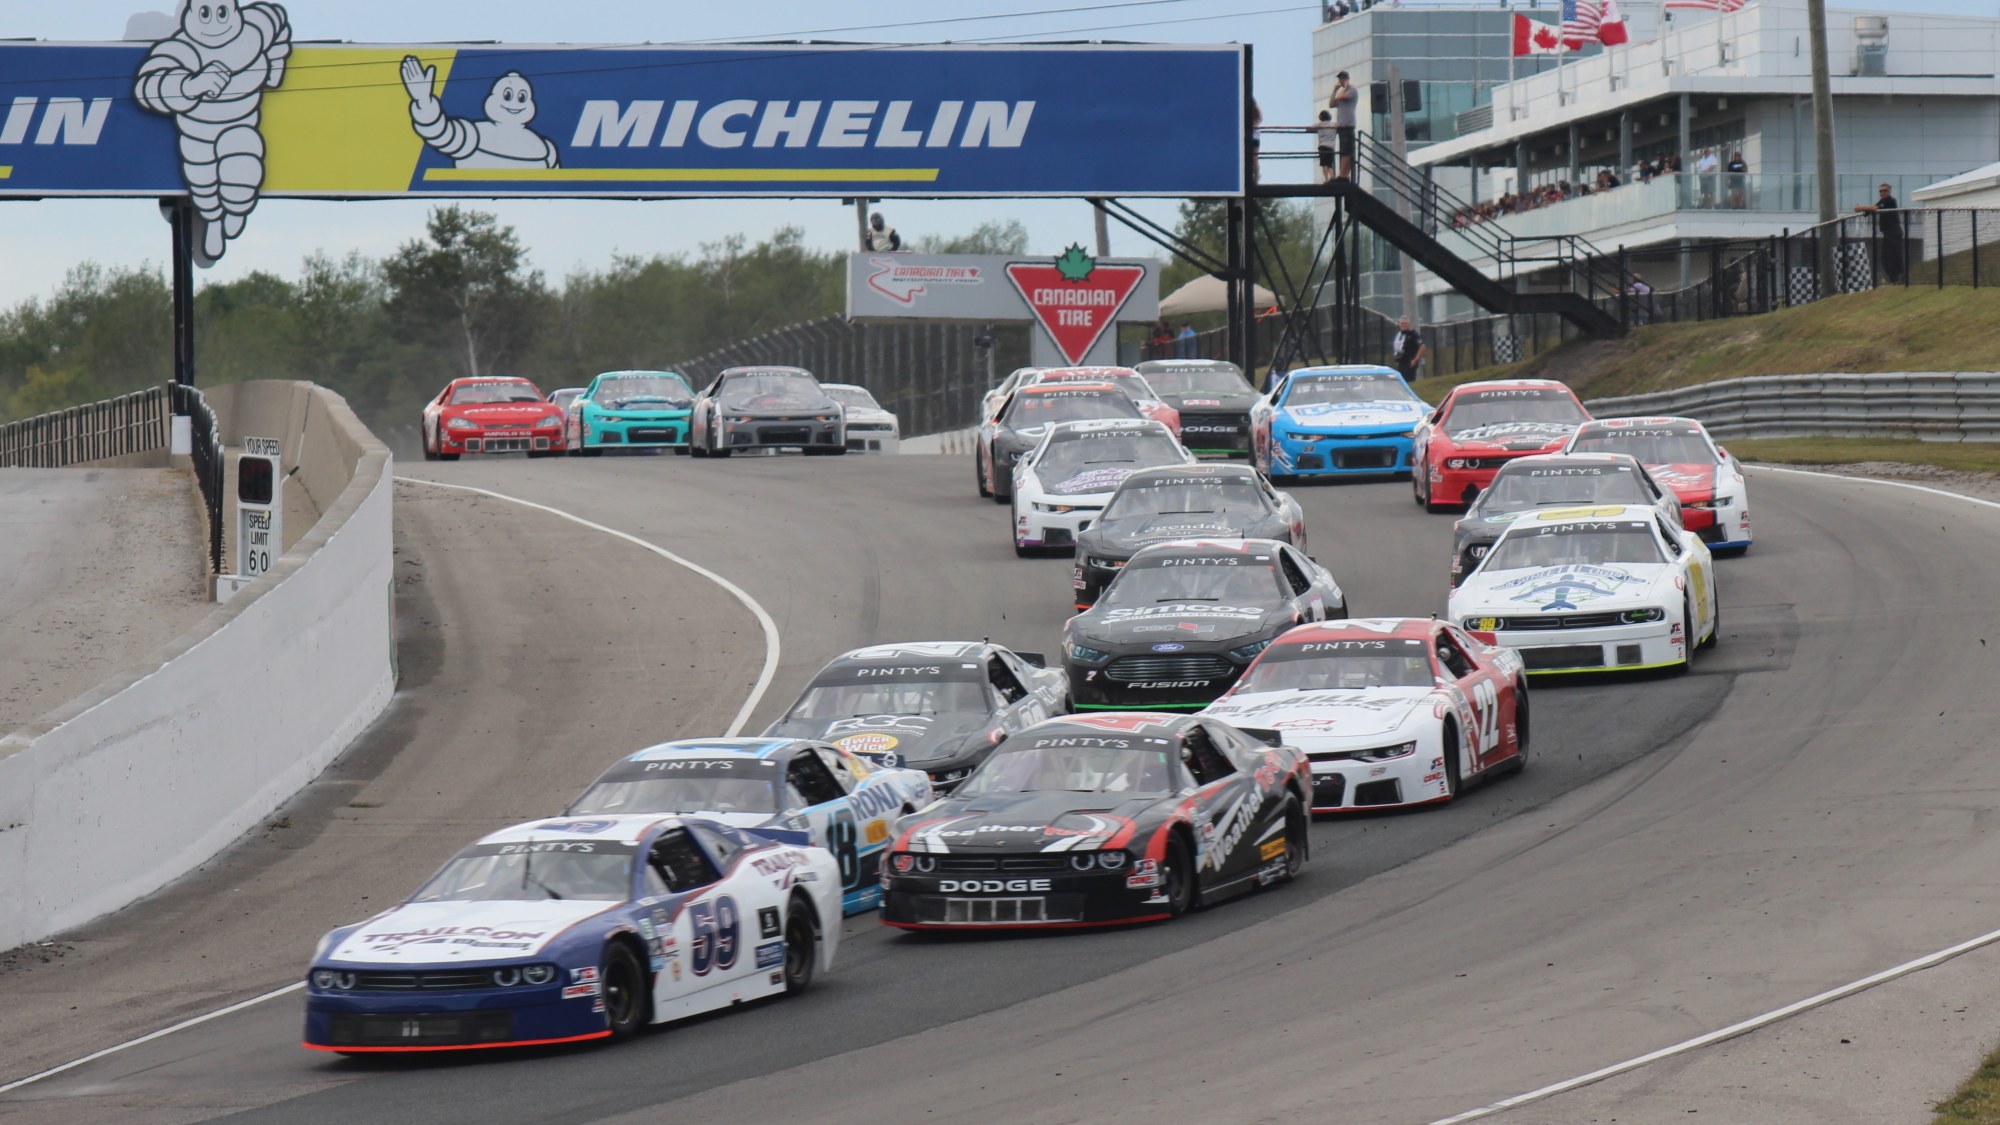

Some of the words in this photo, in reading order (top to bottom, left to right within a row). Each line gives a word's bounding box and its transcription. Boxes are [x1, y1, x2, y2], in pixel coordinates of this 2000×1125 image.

[570, 100, 1036, 148] MICHELIN
[894, 267, 943, 277] CANADIAN
[946, 267, 967, 277] TIRE
[1034, 288, 1116, 305] CANADIAN
[1057, 309, 1092, 326] TIRE
[1481, 390, 1541, 398] PINTY'S
[1081, 431, 1143, 439] PINTY'S
[246, 438, 261, 455] YOUR
[262, 439, 280, 456] SPEED
[1531, 468, 1601, 476] PINTY'S
[1154, 477, 1222, 486] PINTY'S
[249, 515, 270, 530] SPEED
[1541, 522, 1617, 535] PINTY'S
[250, 532, 269, 546] LIMIT
[1162, 557, 1239, 567] PINTY'S
[1107, 603, 1265, 618] Simcoe
[1479, 616, 1496, 631] 99
[1302, 641, 1387, 652] PINTY'S
[857, 666, 941, 677] PINTY'S
[1086, 671, 1098, 682] 7
[1127, 680, 1210, 690] FUSION
[1473, 678, 1500, 755] 22
[825, 714, 935, 735] RGC
[1034, 737, 1130, 749] PINTY'S
[645, 759, 734, 772] PINTY'S
[499, 842, 596, 855] PINTY'S
[939, 879, 1052, 892] DODGE
[362, 927, 547, 944] TRAILCON
[688, 893, 740, 978] 59
